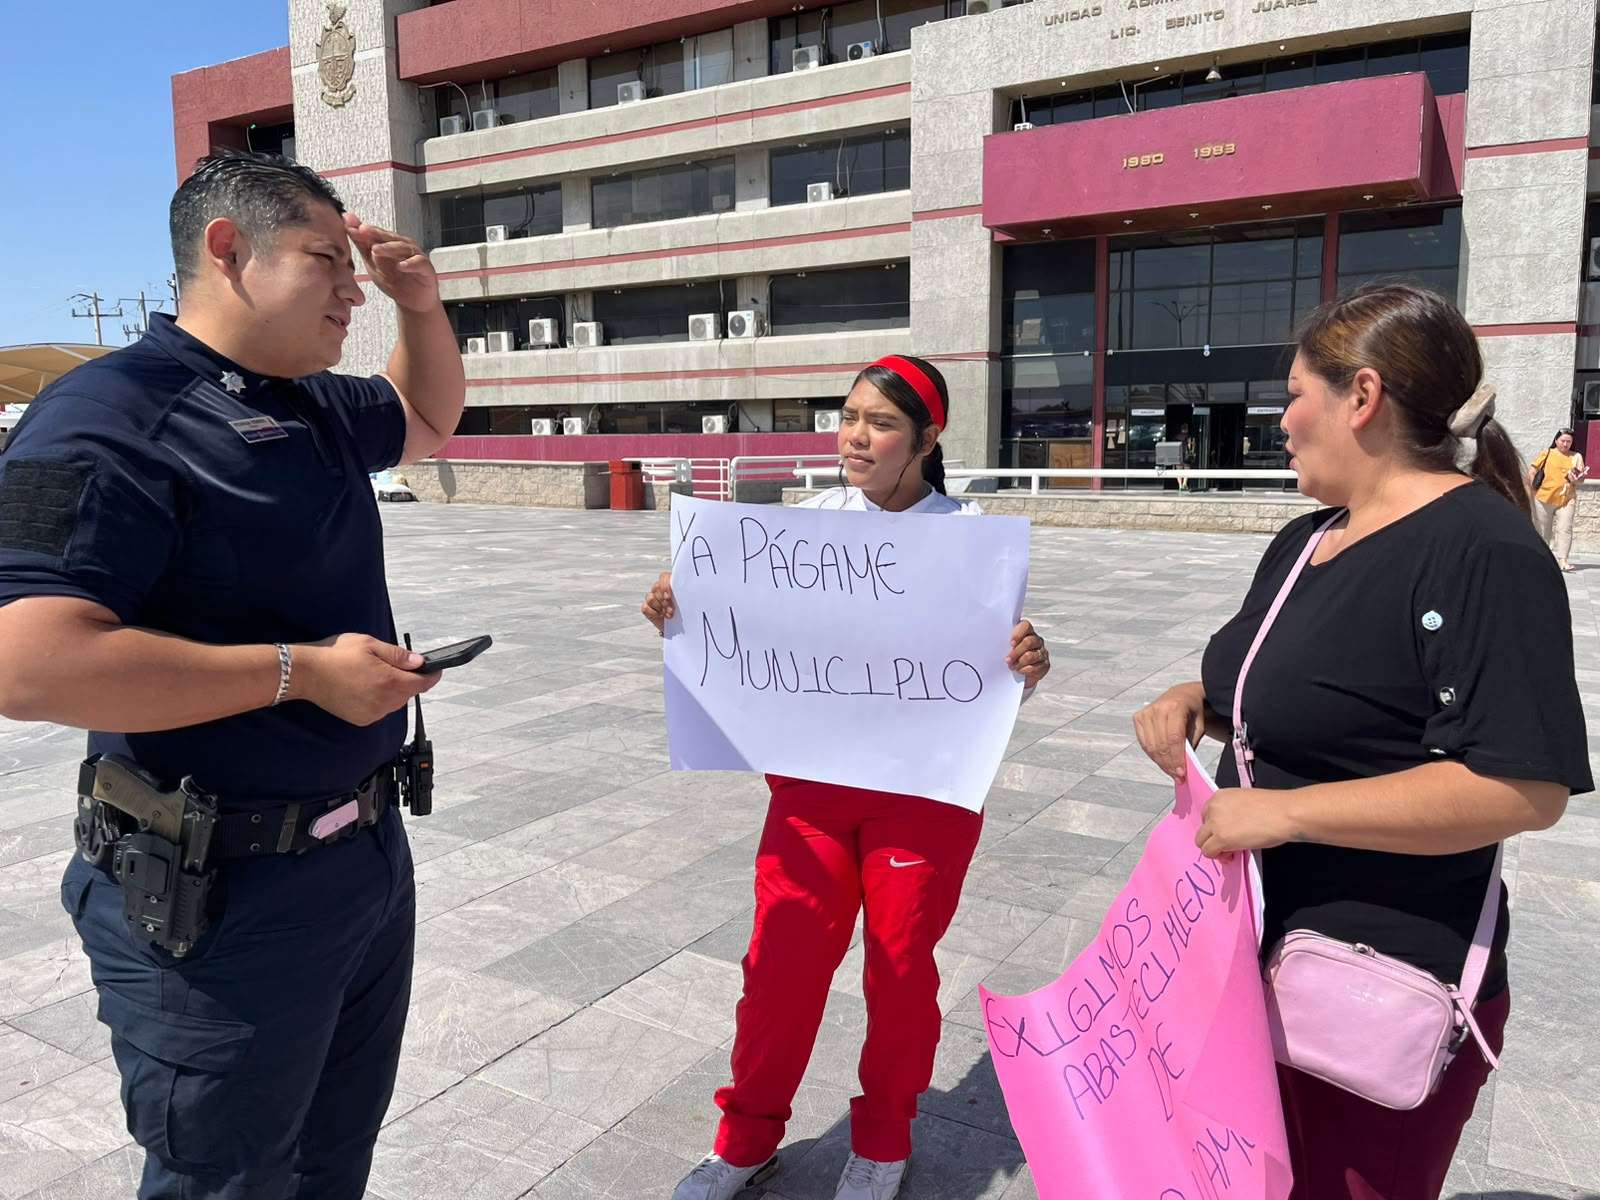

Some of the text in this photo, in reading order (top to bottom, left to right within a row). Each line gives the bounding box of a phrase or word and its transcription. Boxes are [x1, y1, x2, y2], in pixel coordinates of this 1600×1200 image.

[1044, 6, 1102, 26] UNIDAD
[1110, 25, 1141, 40] LIC.
[1165, 9, 1225, 30] BENITO
[1122, 143, 1236, 169] 1980 1983
[671, 510, 905, 600] YA PÁGAME
[700, 606, 984, 703] MUNICIPIO
[985, 897, 1152, 1058] EXIGIMOS
[1063, 854, 1221, 1120] ABASTECIMIEN
[1147, 1022, 1185, 1122] DE
